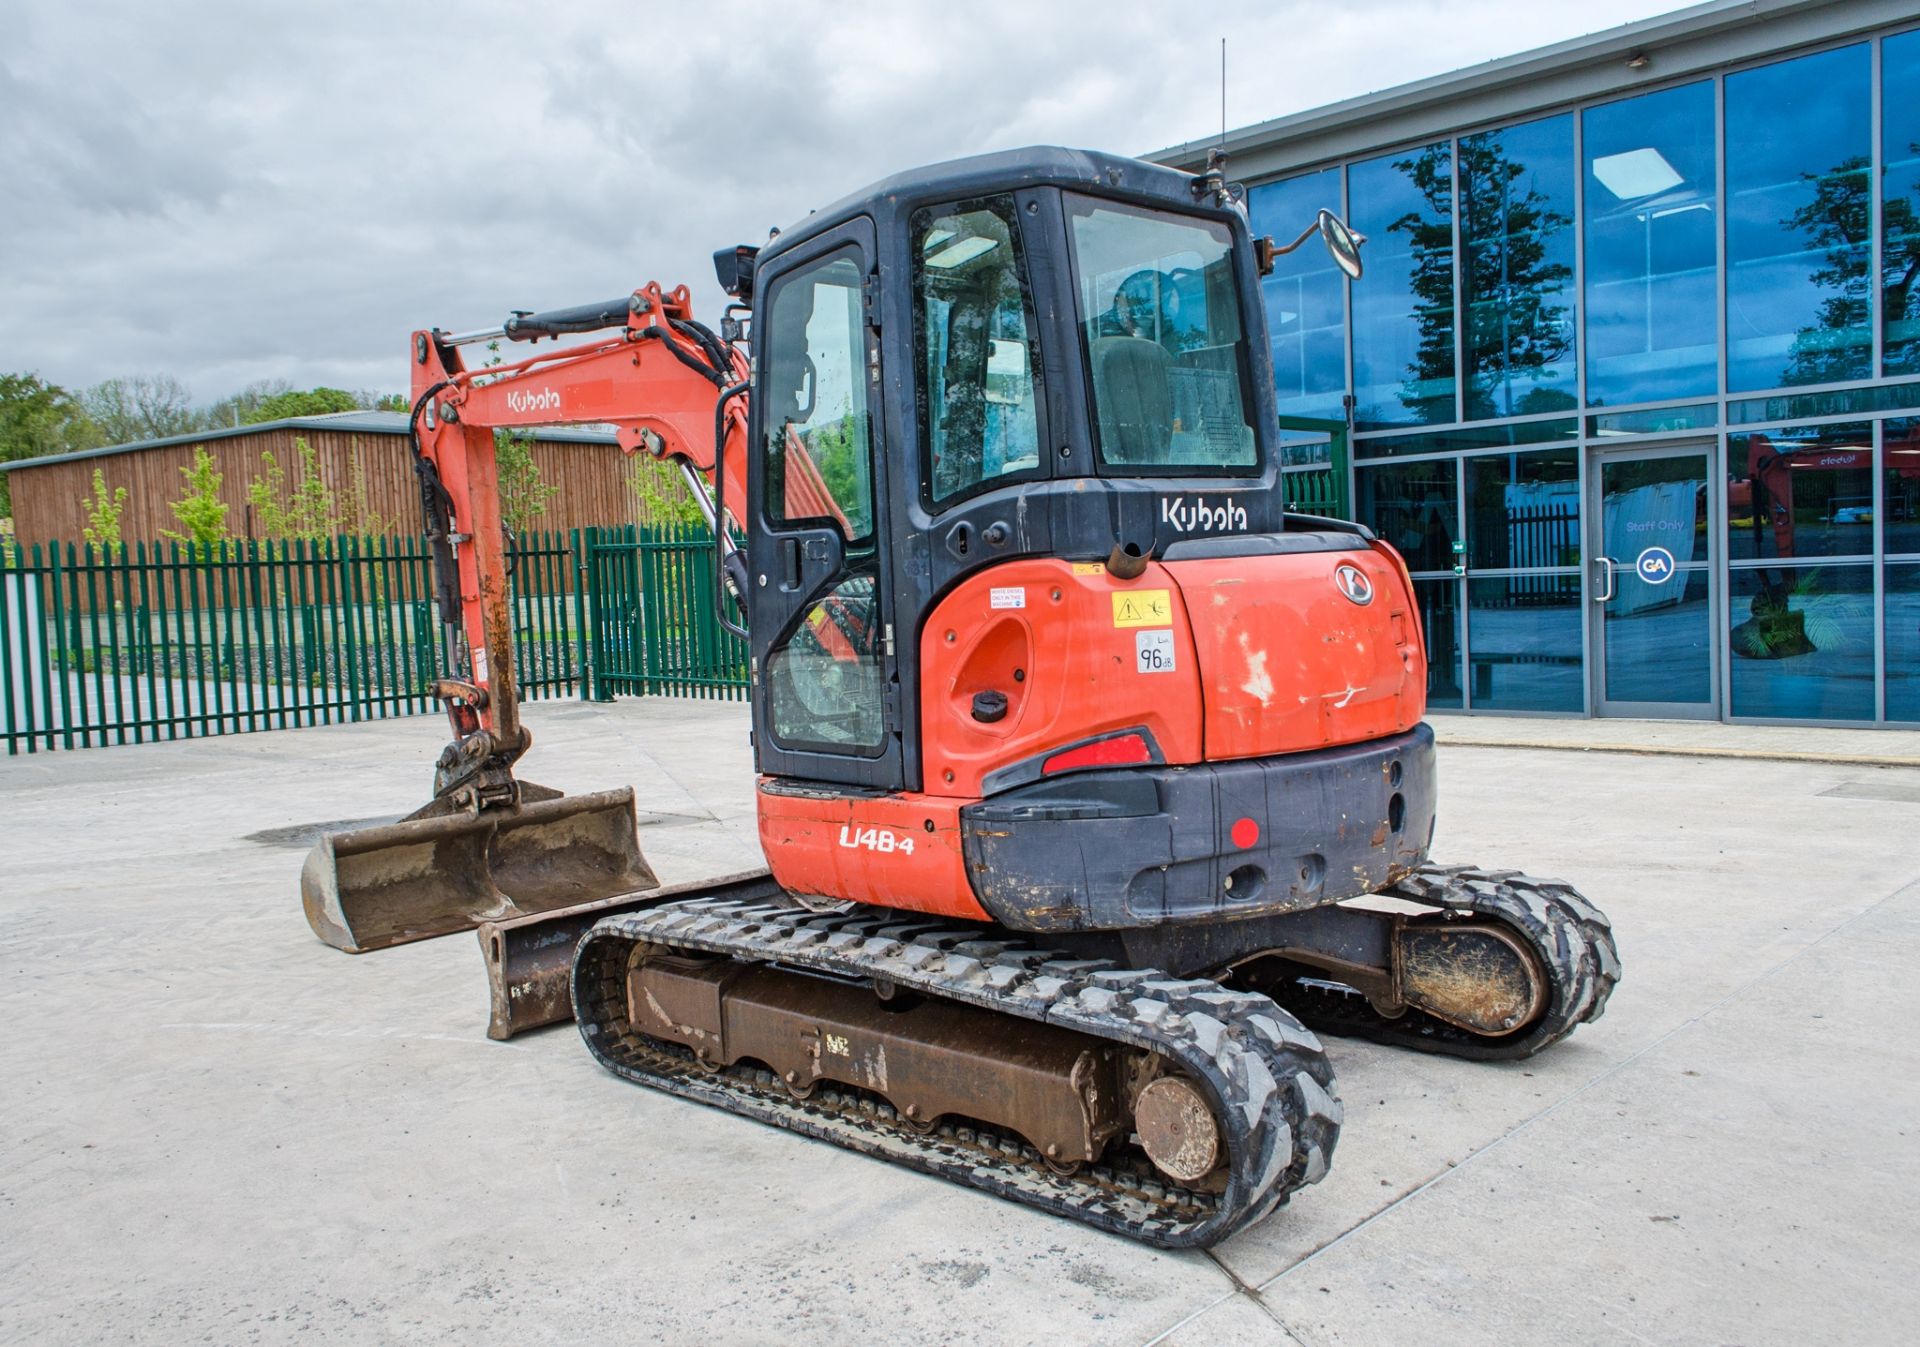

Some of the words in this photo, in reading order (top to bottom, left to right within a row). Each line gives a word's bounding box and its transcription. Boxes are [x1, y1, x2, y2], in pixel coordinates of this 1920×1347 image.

[507, 387, 560, 413] Kubota
[1161, 497, 1248, 532] Kubota
[1626, 521, 1656, 533] Staff
[1657, 519, 1685, 532] Only
[1642, 558, 1668, 574] GA
[1140, 648, 1163, 670] 96
